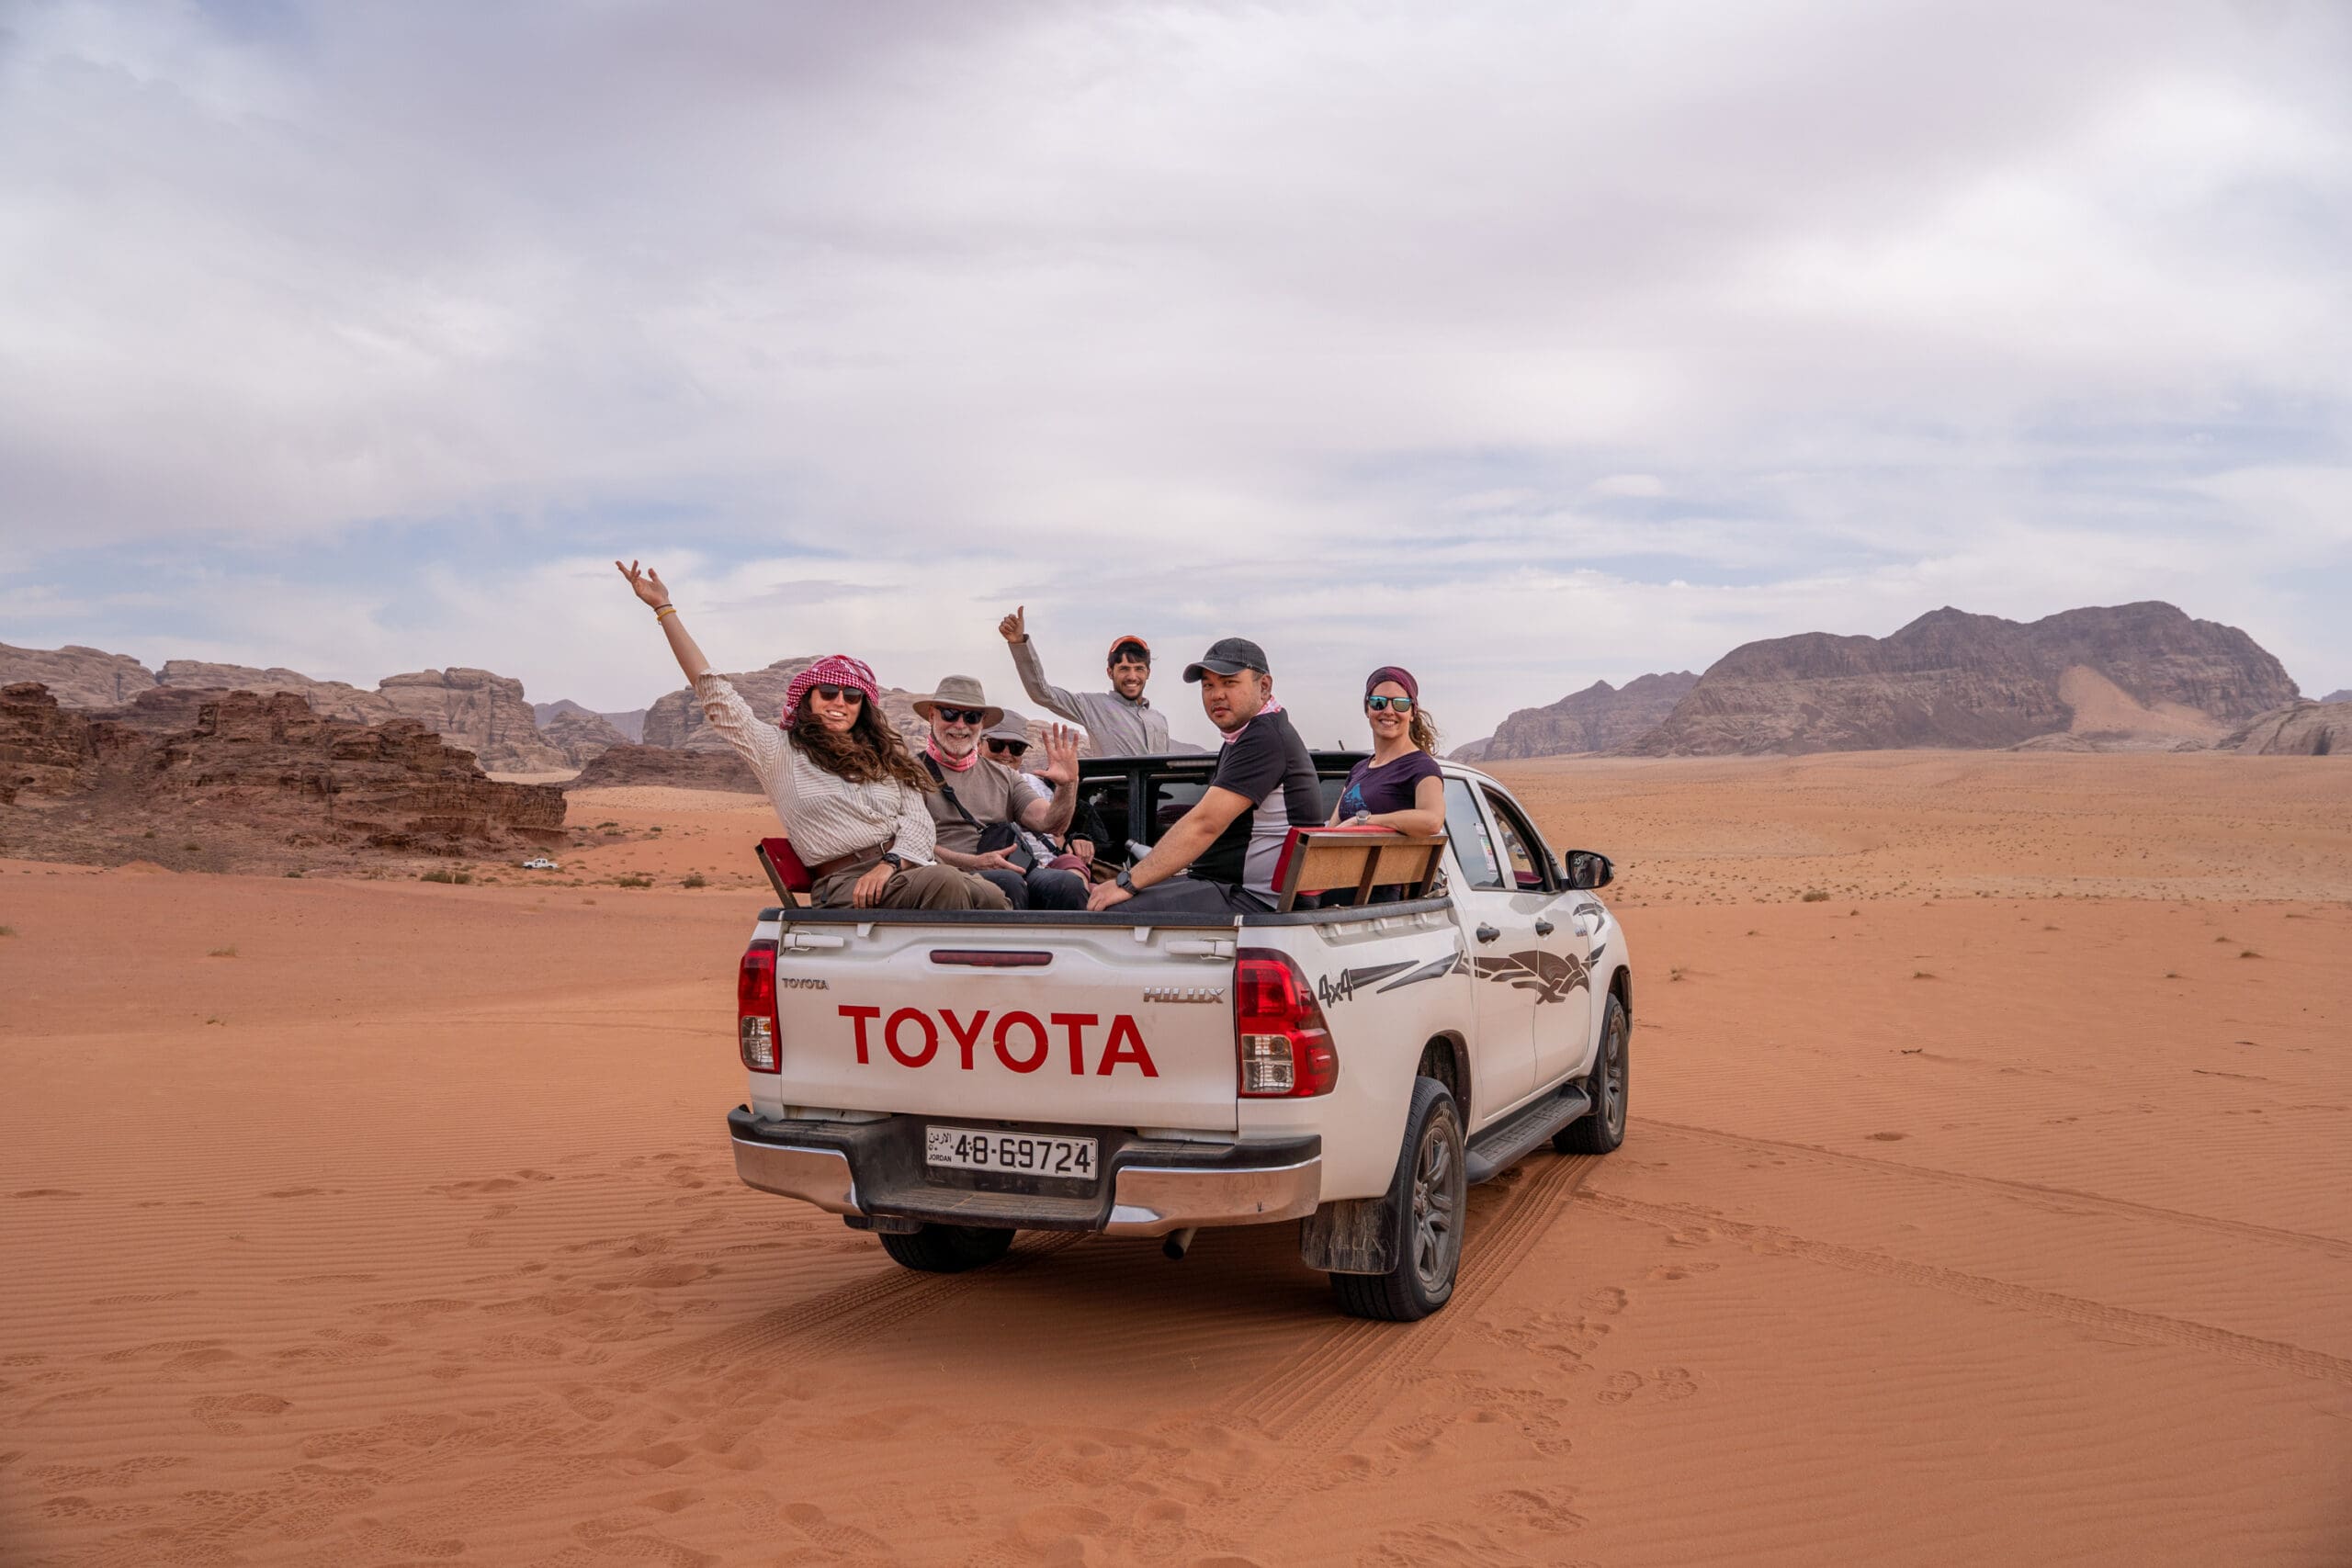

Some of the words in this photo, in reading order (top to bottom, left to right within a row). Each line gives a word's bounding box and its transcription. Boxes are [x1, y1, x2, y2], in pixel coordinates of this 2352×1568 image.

[781, 977, 831, 991] TOYOTA
[1143, 987, 1226, 1004] HILUX
[1318, 968, 1353, 1009] 4x4
[838, 1004, 1159, 1078] TOYOTA
[928, 1154, 952, 1162] JORDAN
[955, 1134, 1091, 1174] 48-69724
